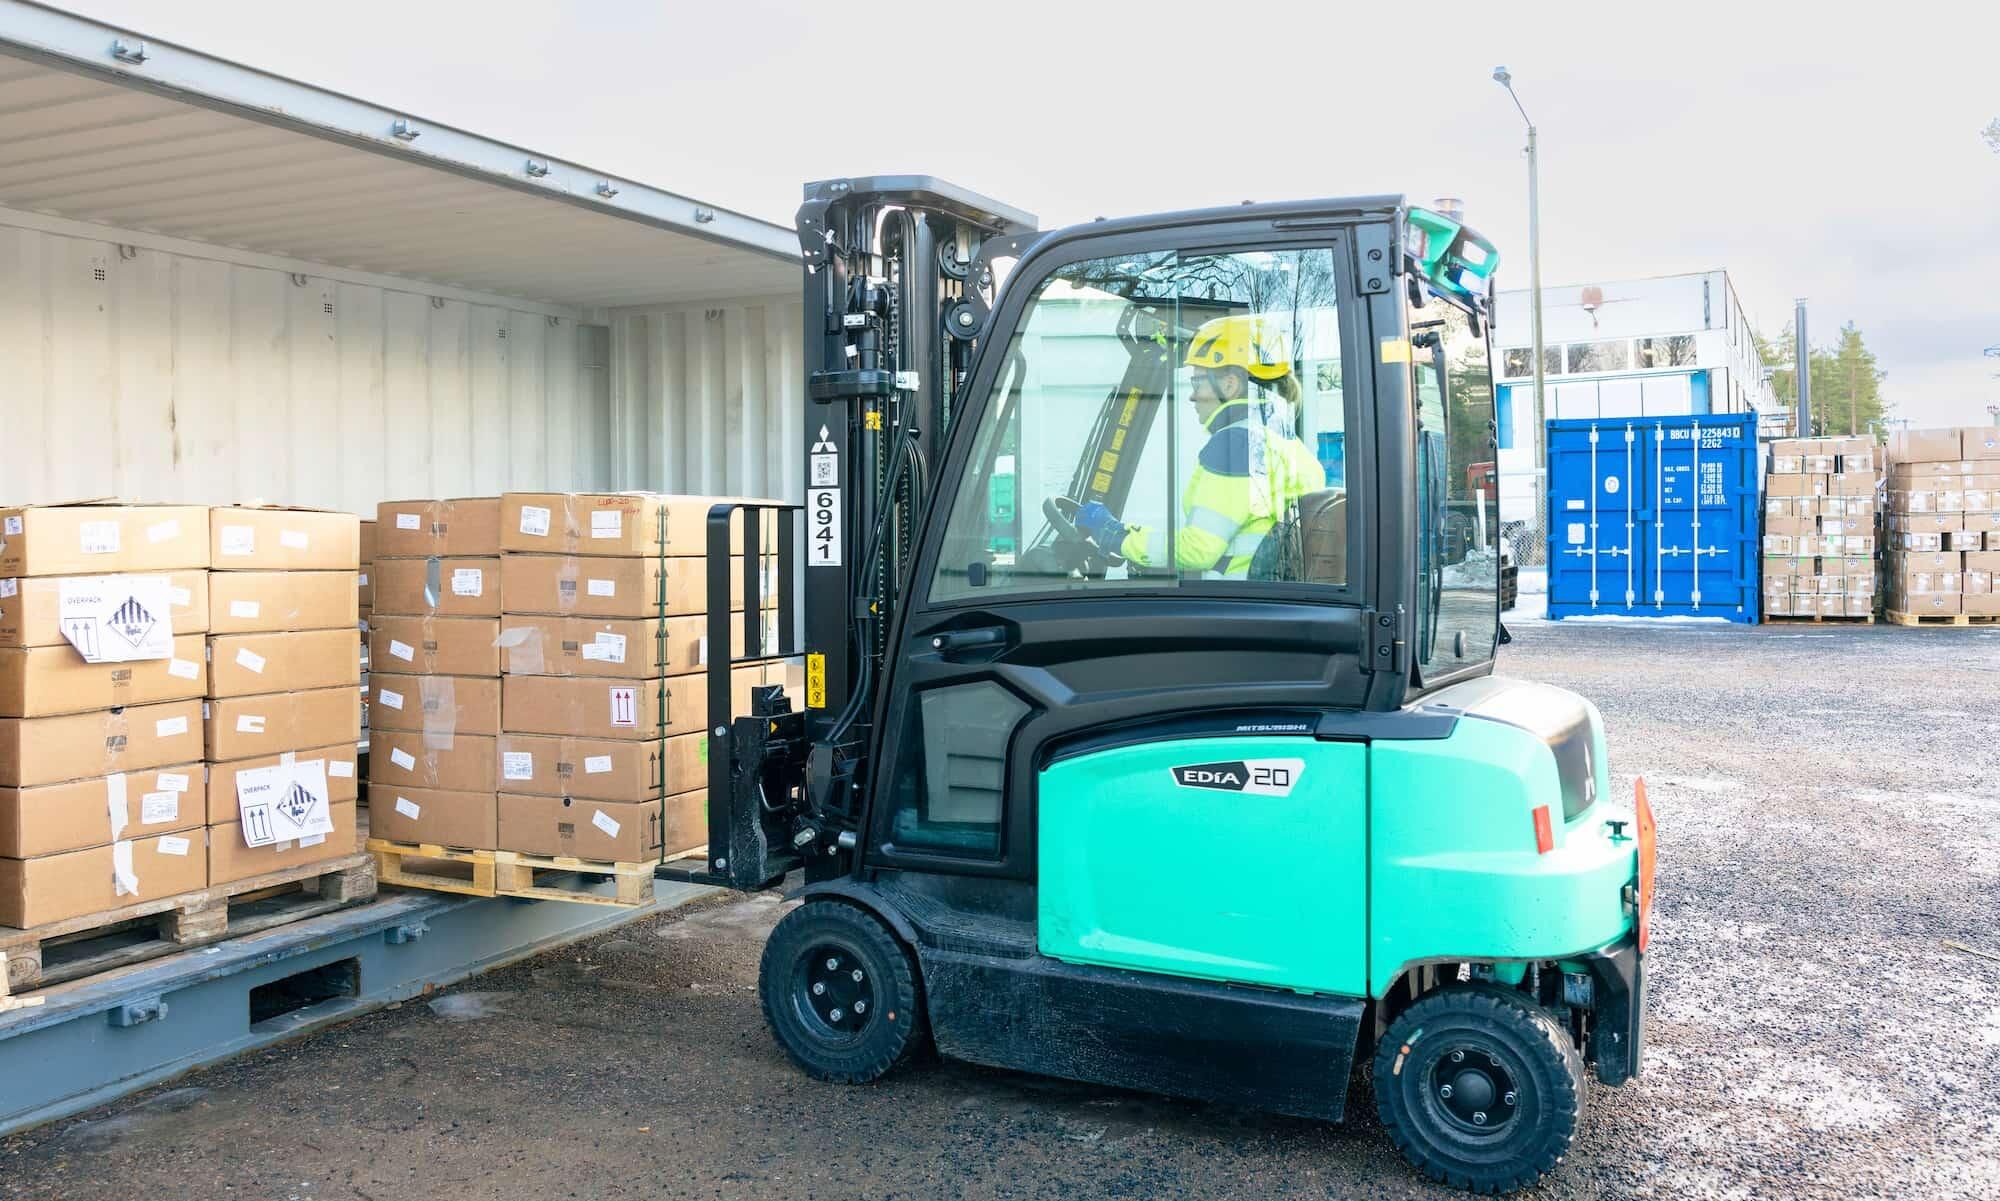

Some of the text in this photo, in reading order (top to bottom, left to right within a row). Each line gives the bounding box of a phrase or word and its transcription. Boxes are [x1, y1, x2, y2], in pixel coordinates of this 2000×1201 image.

[1670, 429, 1690, 440] BBCU
[1702, 428, 1732, 439] 225843
[1702, 439, 1722, 448] 22G2
[816, 492, 834, 559] 6941
[1254, 768, 1289, 786] 20
[243, 784, 271, 795] OVERPACK
